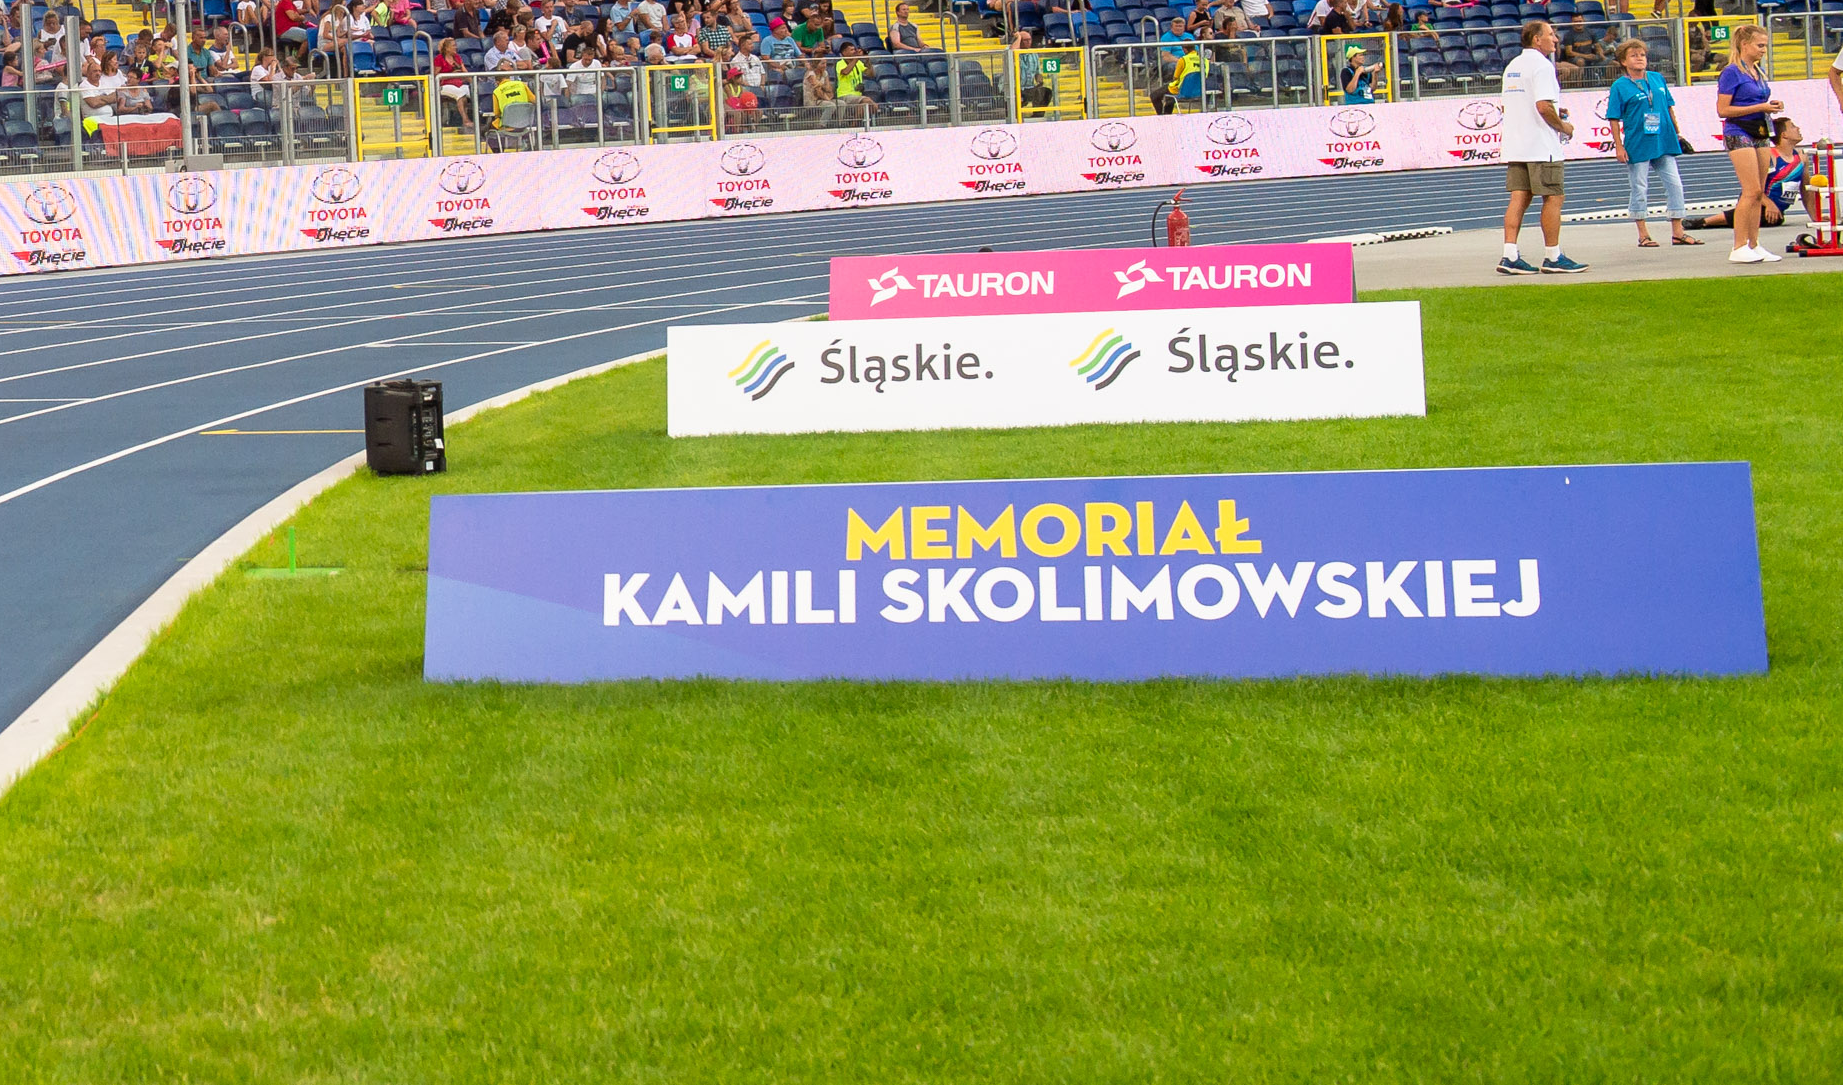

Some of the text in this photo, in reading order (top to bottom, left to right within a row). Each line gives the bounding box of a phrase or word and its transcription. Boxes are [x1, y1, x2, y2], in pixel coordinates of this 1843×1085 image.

[1714, 27, 1727, 39] 65
[1046, 60, 1058, 72] 63
[674, 76, 687, 90] 62
[387, 90, 399, 104] 61
[1456, 133, 1502, 145] TOYOT
[1328, 141, 1380, 153] TOYOTA
[1089, 156, 1141, 167] TOYOTA
[1206, 148, 1259, 161] TOYOTA
[968, 163, 1022, 175] TOYOTA
[836, 172, 889, 184] TOYOTA
[718, 180, 770, 193] TOYOTA
[591, 188, 645, 201] TOYOTA
[437, 198, 490, 213] TOYOTA
[310, 208, 367, 222] TOYOTA
[164, 218, 222, 233] TOYOTA
[24, 228, 81, 244] TOYOTA
[1165, 262, 1312, 291] TAURON
[916, 270, 1055, 299] TAURON
[1167, 326, 1354, 384] Śląskie.
[819, 338, 994, 394] Śląskie.
[846, 499, 1262, 561] MEMORIAŁ
[603, 558, 1542, 627] KAMILI SKOLIMOWSKIEJ
